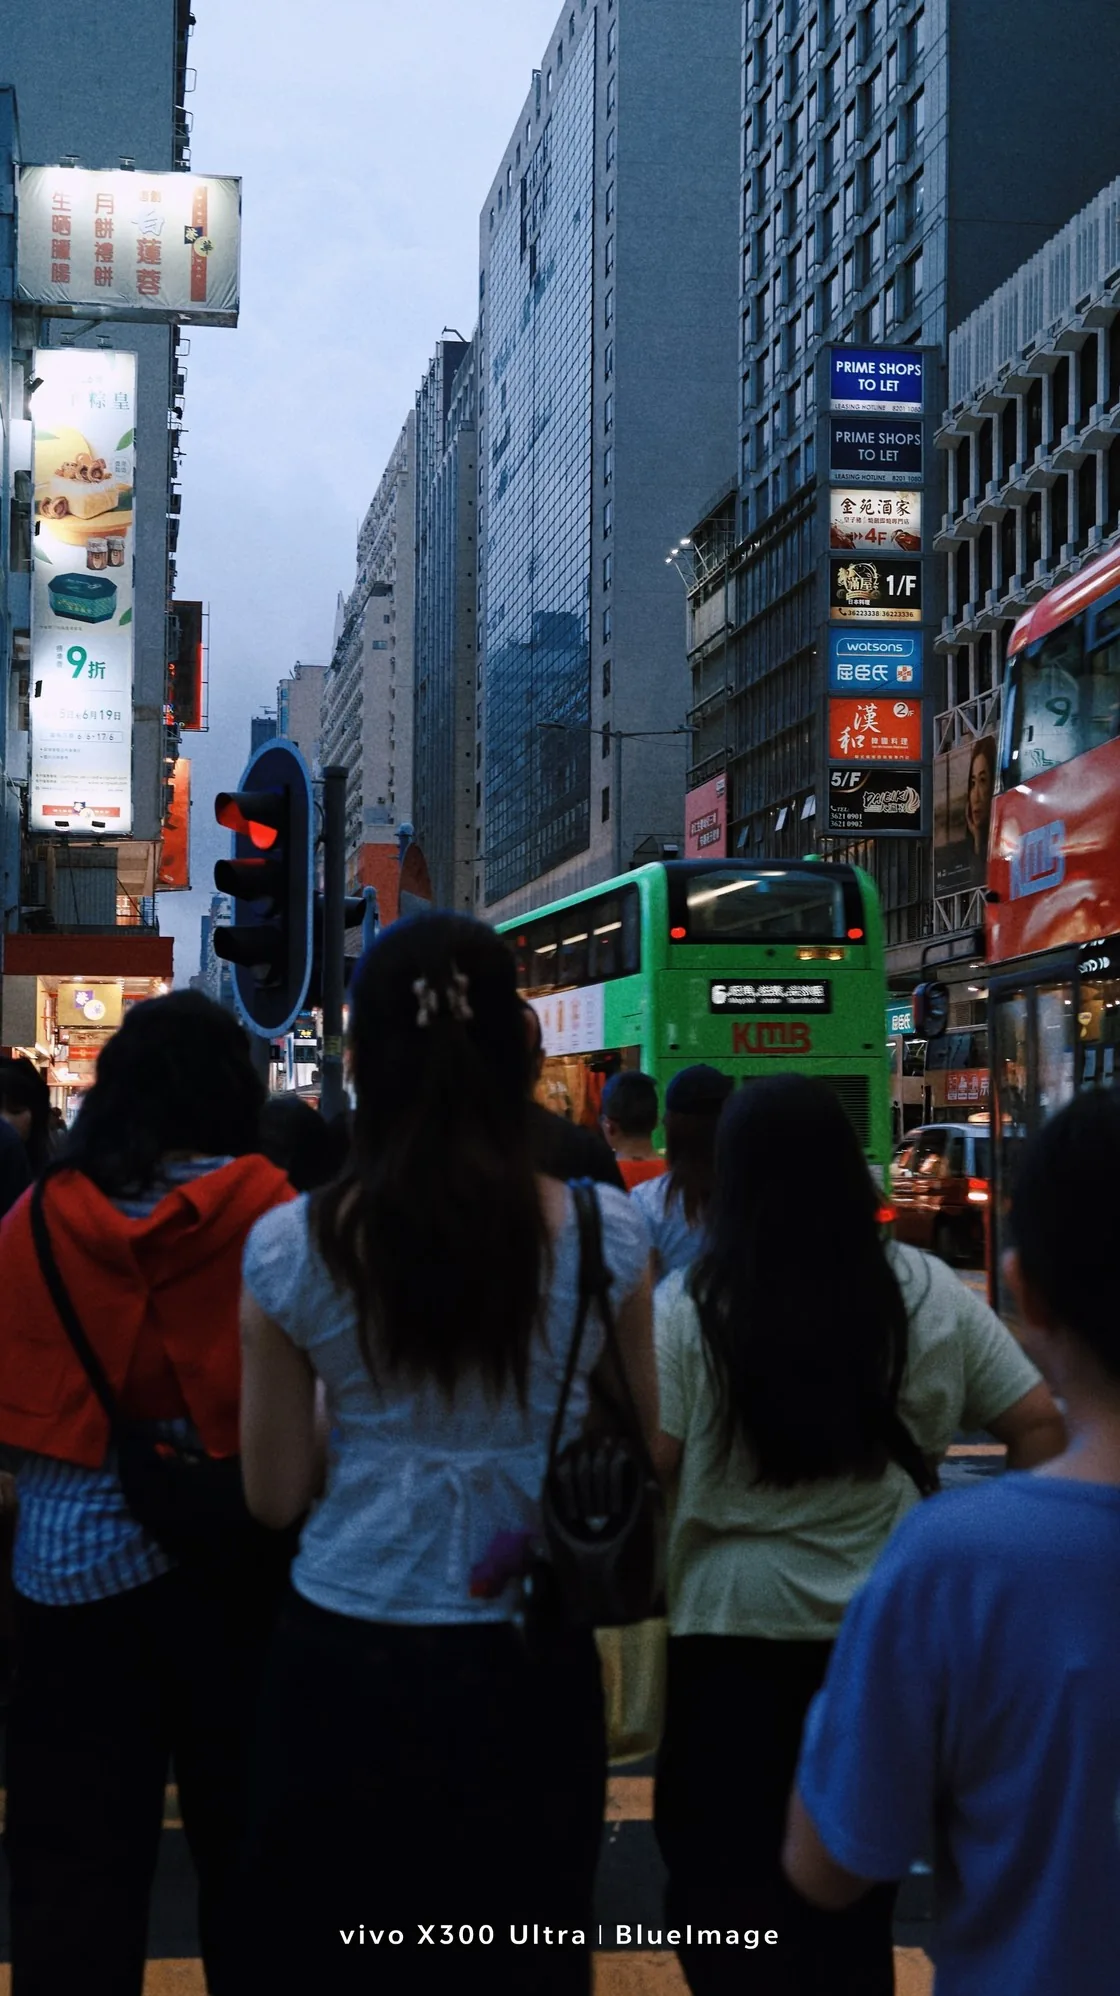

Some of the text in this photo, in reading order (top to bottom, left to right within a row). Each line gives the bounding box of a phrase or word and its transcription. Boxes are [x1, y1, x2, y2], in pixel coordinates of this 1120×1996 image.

[836, 360, 922, 376] PRIME SHOPS
[858, 378, 900, 392] TO LET
[835, 431, 921, 446] PRIME SHOPS
[858, 449, 899, 462] TO LET
[840, 497, 911, 517] 金苑酒家
[864, 527, 887, 546] 4F
[886, 574, 917, 596] 1/F
[846, 640, 903, 653] watsons
[66, 645, 107, 680] 9折
[836, 663, 889, 682] 屈臣氏
[830, 771, 862, 787] 5/F
[830, 812, 863, 821] 3621 0901
[830, 820, 863, 828] 3621 0902
[732, 1022, 812, 1054] KMB
